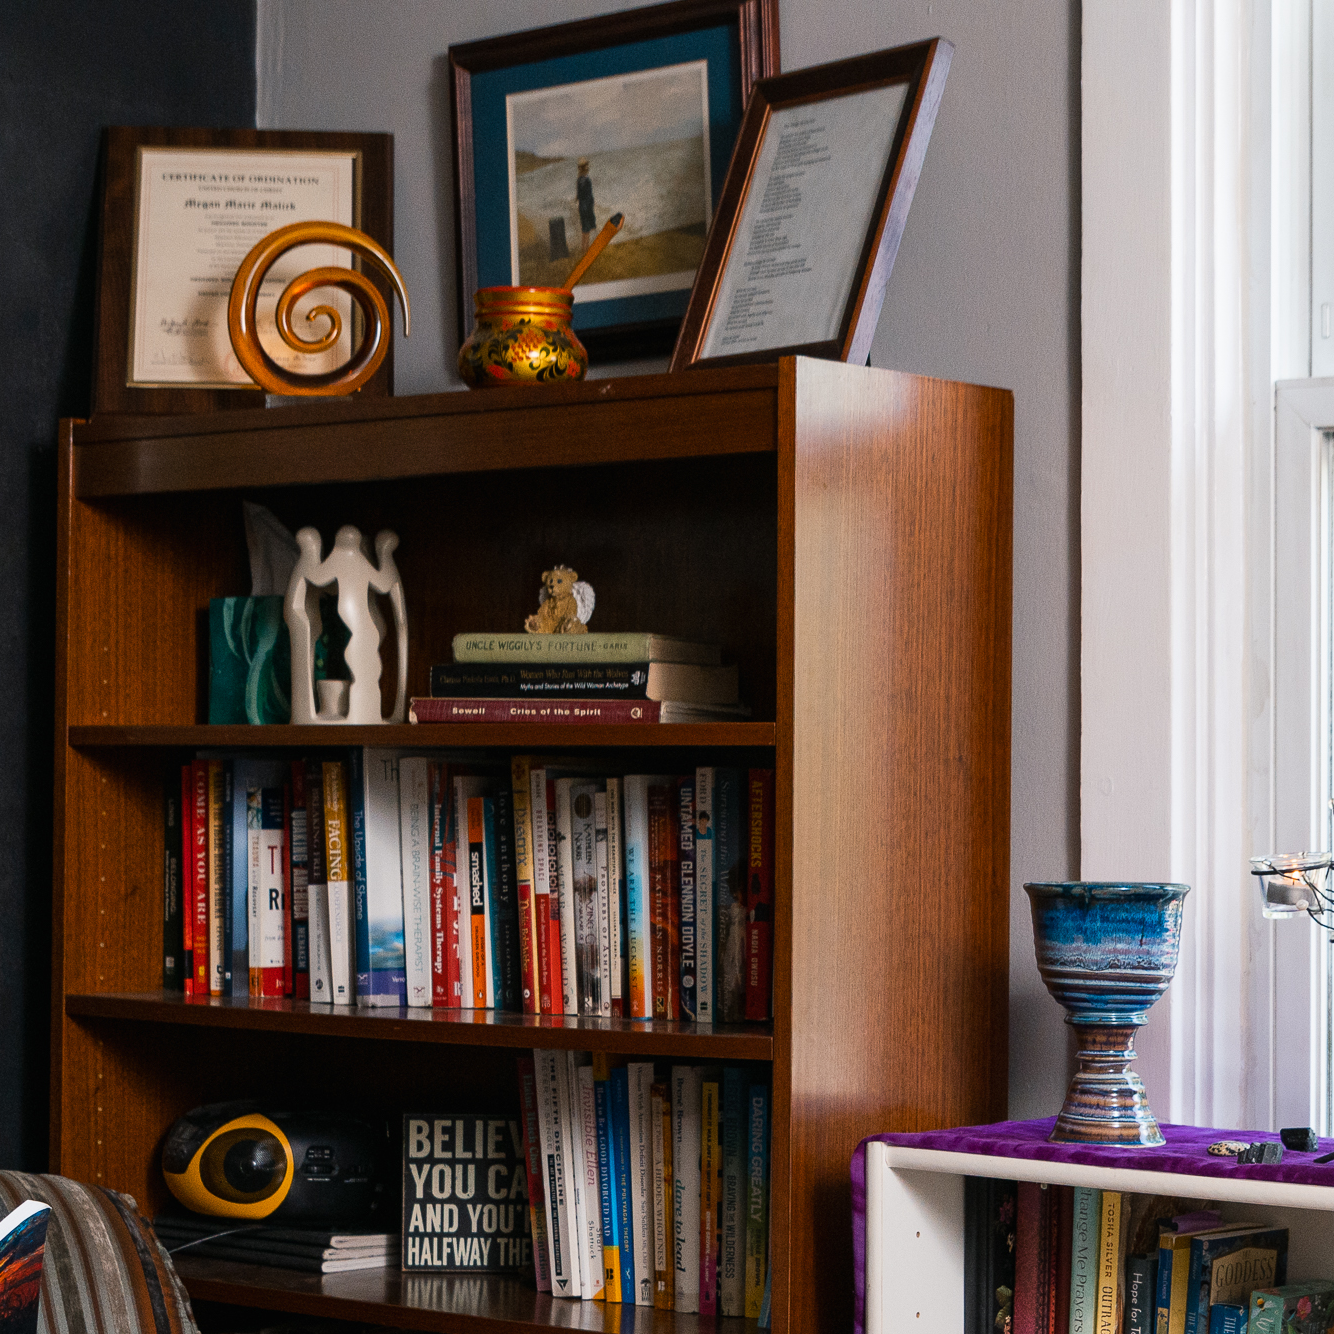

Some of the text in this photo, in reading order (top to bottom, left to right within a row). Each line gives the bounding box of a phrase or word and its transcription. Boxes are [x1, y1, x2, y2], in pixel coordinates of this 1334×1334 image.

[162, 173, 320, 185] CERTIFICATE OF ORDINATION
[466, 640, 596, 651] UNCLE WIGGILY'S FORTUNE
[452, 707, 601, 716] Sewell Cries of the Spirit
[750, 781, 762, 868] AFTERSHOCKS
[195, 771, 207, 925] COME AS YOU ARE
[327, 819, 342, 881] FACING
[354, 811, 366, 920] The Upside of Shame
[433, 804, 445, 975] Internal Family Systems Therapy
[471, 852, 484, 907] smashed
[680, 787, 695, 968] UNTAMED GLENNON DOYLE
[750, 1097, 764, 1223] DARING GREATLY
[409, 1164, 475, 1199] YOU
[409, 1203, 459, 1233] AND
[1106, 1203, 1115, 1238] TOSHA
[407, 1237, 491, 1266] HALFWAY
[1104, 1240, 1113, 1278] SILVER
[1132, 1273, 1143, 1304] Hope
[1216, 1257, 1274, 1287] GODDESS
[1131, 1307, 1142, 1324] for
